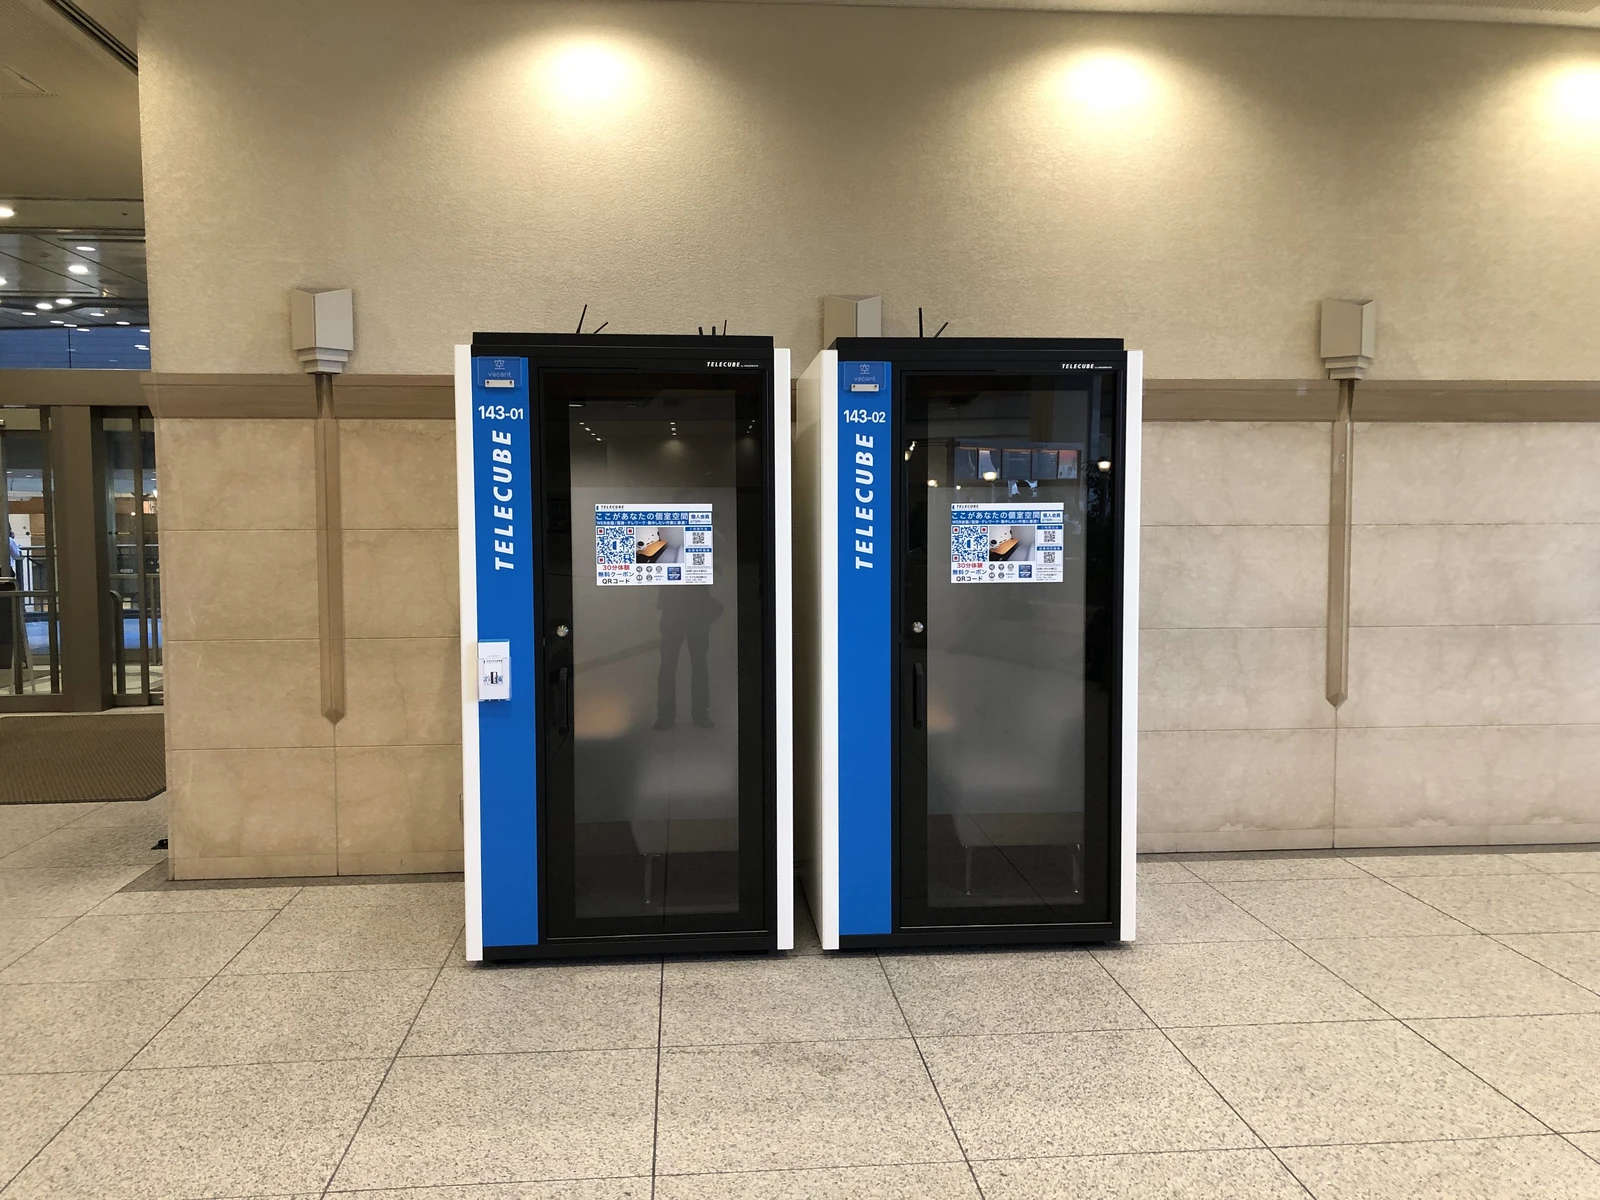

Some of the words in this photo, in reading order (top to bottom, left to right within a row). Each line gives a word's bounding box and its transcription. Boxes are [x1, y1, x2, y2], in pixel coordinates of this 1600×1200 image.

[478, 405, 524, 420] 143-01
[844, 409, 886, 424] 143-02
[492, 430, 514, 571] TELECUBE
[855, 434, 874, 570] TELECUBE
[596, 512, 688, 520] ここがあなたの個室空間
